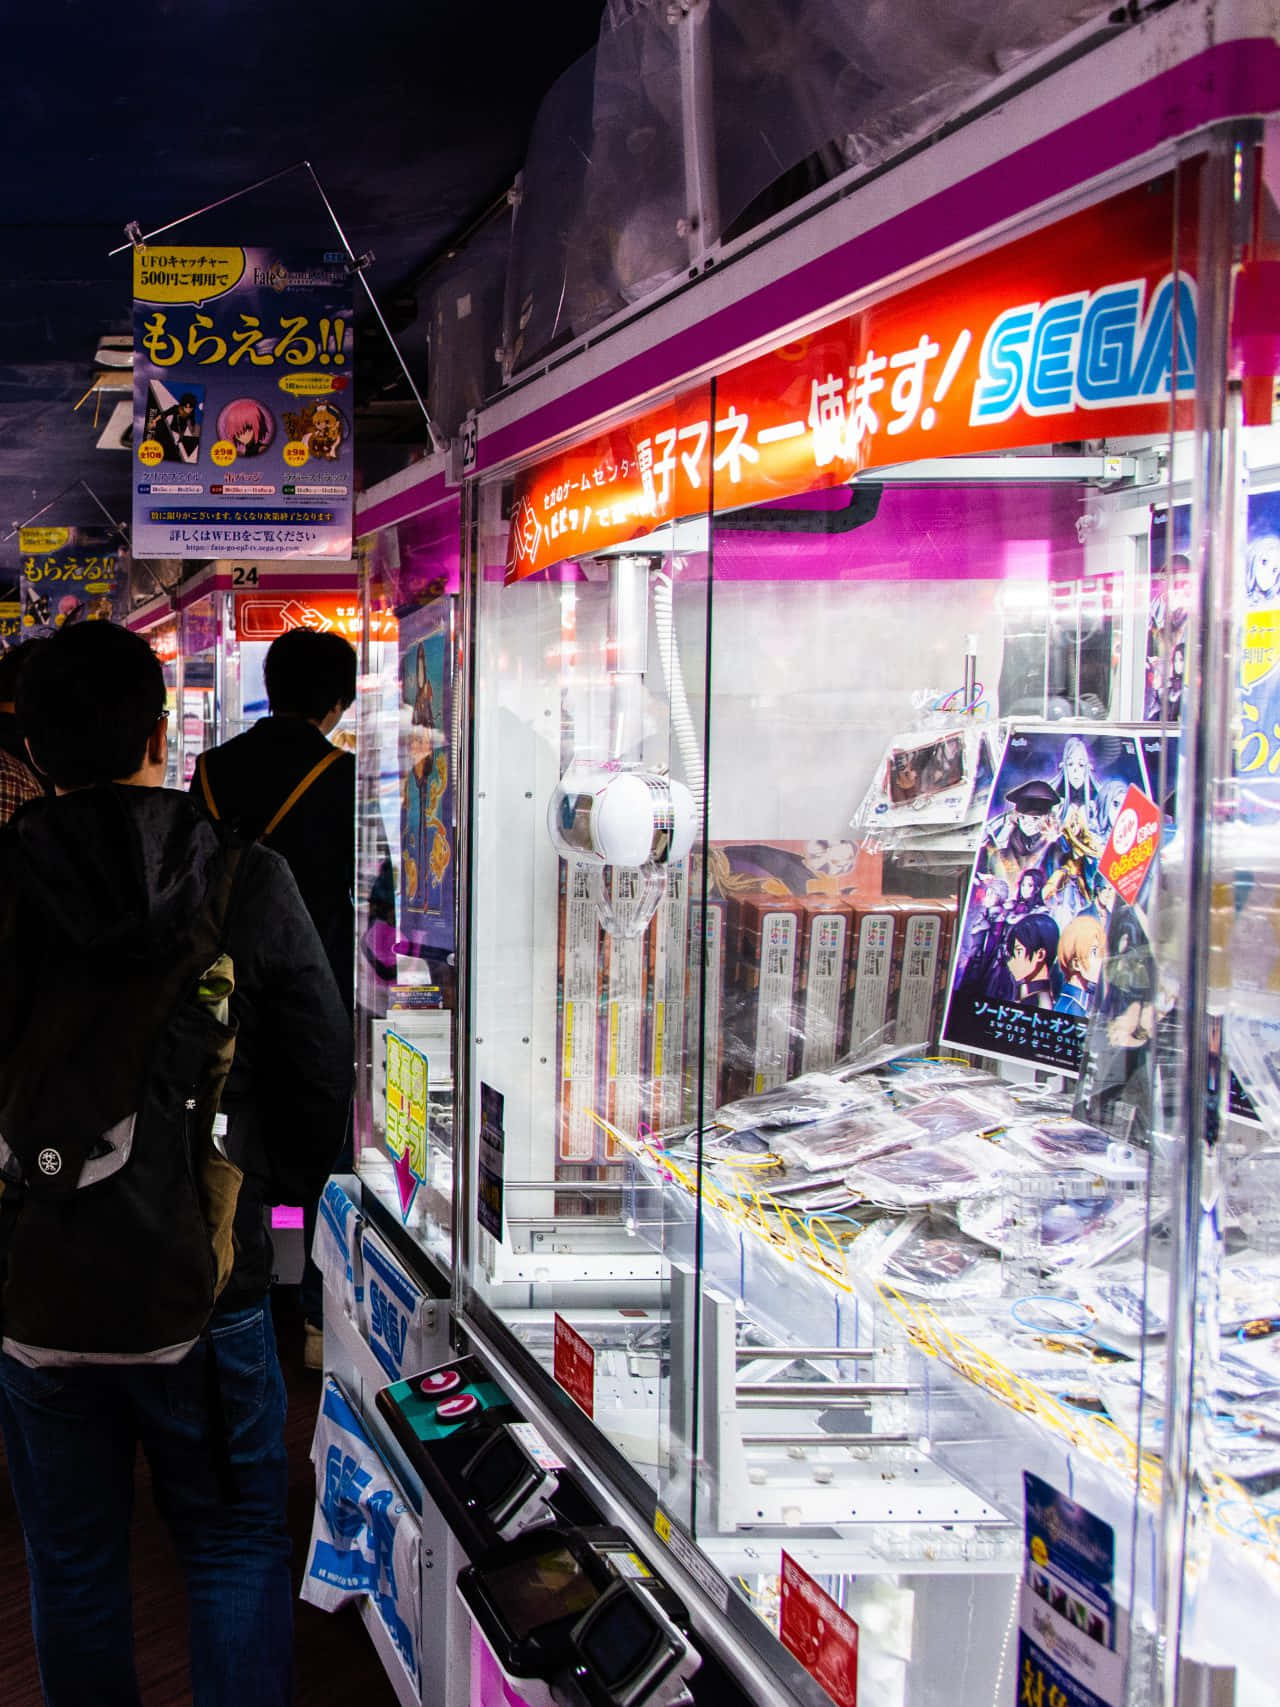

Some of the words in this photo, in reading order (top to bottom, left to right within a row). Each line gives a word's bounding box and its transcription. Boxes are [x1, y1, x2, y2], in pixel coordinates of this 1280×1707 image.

[140, 256, 228, 268] UFOキャッチャー
[140, 271, 229, 287] 500円ご利用で
[142, 312, 346, 367] もらえる!!
[969, 270, 1197, 427] SEGA
[233, 567, 258, 585] 24
[974, 1001, 1088, 1038] ソードアート・オンラ
